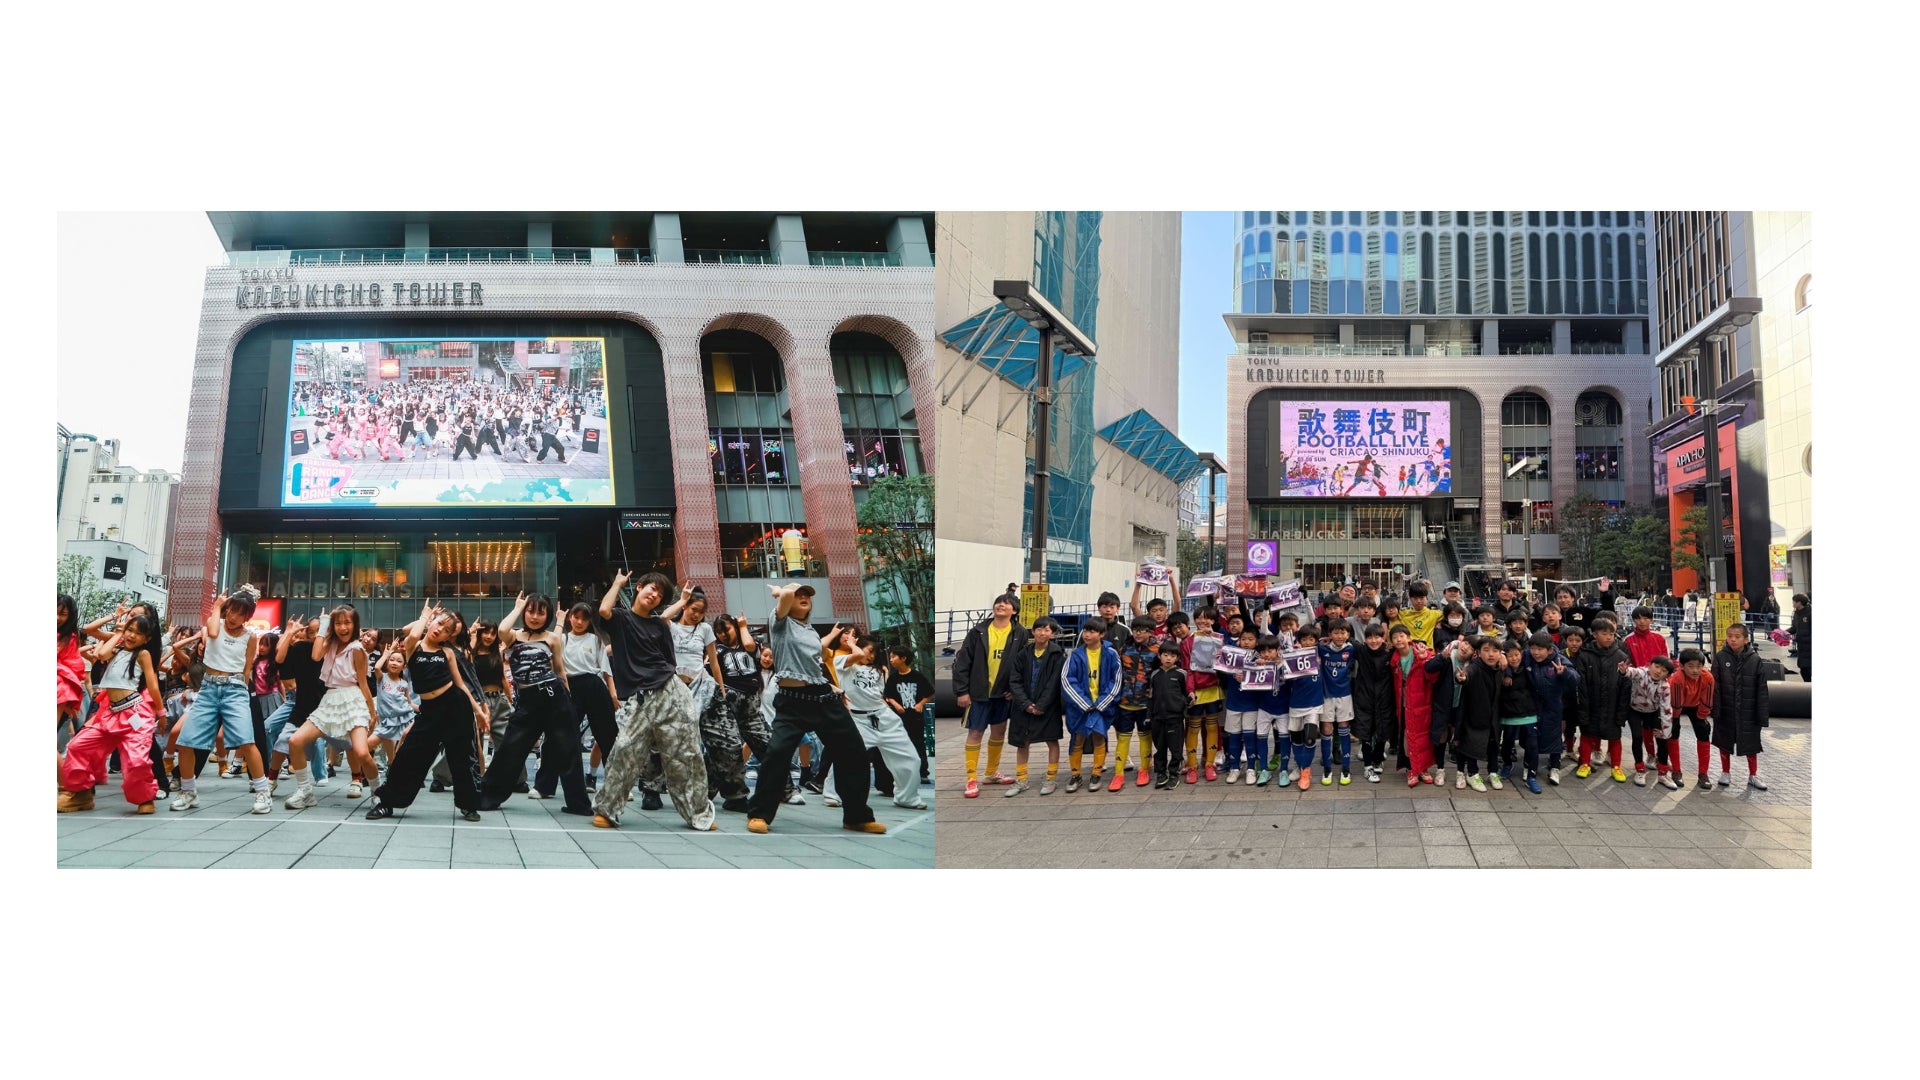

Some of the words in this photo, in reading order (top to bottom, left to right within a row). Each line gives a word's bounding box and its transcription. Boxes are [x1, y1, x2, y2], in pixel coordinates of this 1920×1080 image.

[240, 269, 296, 281] TOKYU
[236, 283, 383, 307] KABUKICHO
[393, 282, 483, 305] TOWER
[1247, 357, 1280, 366] TOKYU
[1246, 368, 1329, 382] KABUKICHO
[1335, 369, 1385, 383] TOWER
[1298, 408, 1431, 436] 歌舞伎町
[1298, 435, 1388, 448] FOOTBALL
[1392, 435, 1430, 448] LIVE
[1329, 447, 1379, 456] CRIACAO
[1382, 447, 1430, 456] SHINJUKU
[1676, 452, 1691, 468] APA
[303, 466, 346, 477] RANDOM
[303, 477, 331, 489] PLAY
[301, 487, 338, 500] DANCE
[1249, 530, 1346, 539] STARBUCKS
[1150, 568, 1162, 580] 39
[1200, 581, 1211, 592] 15
[1247, 581, 1259, 592] 21
[1279, 590, 1292, 601] 44
[1414, 620, 1423, 629] 32
[993, 649, 1005, 660] 15
[1225, 652, 1238, 666] 31
[1296, 656, 1311, 671] 66
[1254, 670, 1266, 683] 18
[1332, 667, 1338, 677] 6
[896, 681, 918, 696] ONE
